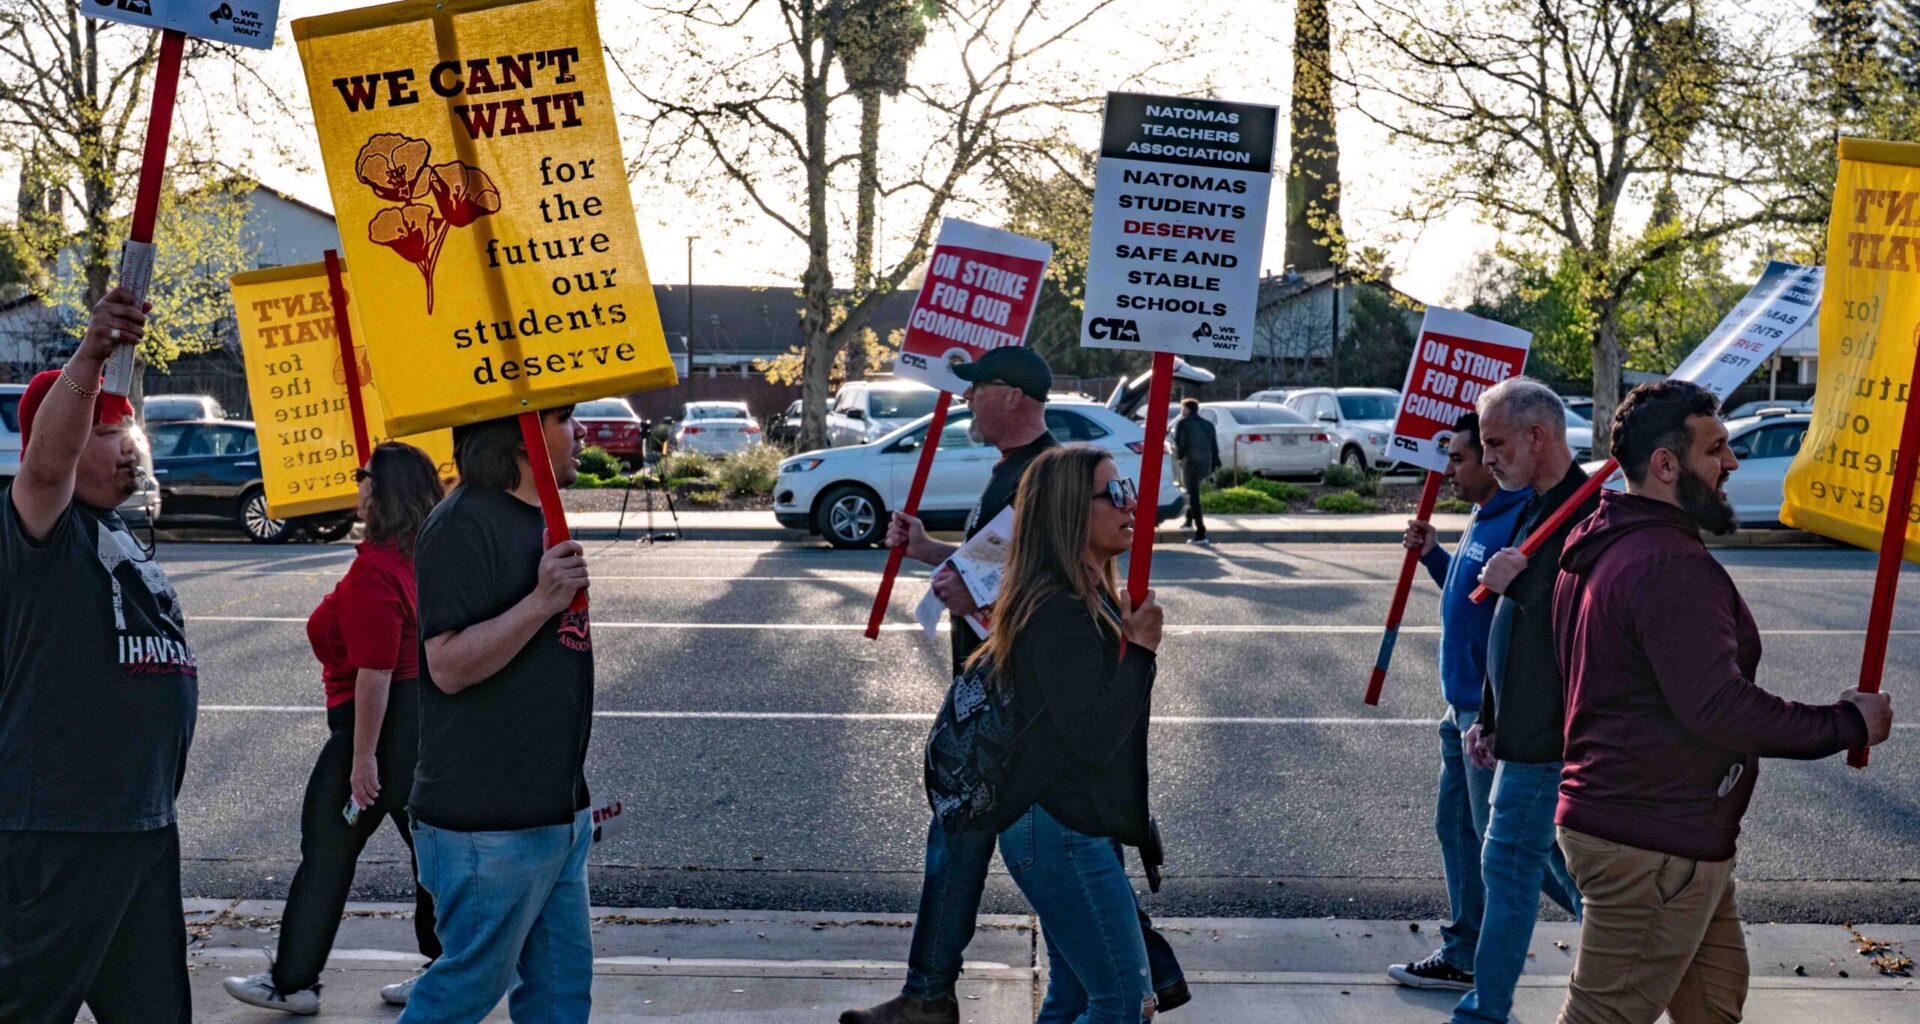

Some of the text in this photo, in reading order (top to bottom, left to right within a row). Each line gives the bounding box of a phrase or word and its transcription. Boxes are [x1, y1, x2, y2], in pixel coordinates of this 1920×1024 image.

[240, 9, 259, 19] WE
[233, 25, 261, 37] WAIT
[332, 47, 579, 112] WE CAN'T
[453, 91, 585, 140] WAIT
[1145, 105, 1240, 124] NATOMAS
[1141, 124, 1240, 143] TEACHERS
[1126, 142, 1250, 164] ASSOCIATION
[539, 156, 595, 185] for
[1123, 169, 1247, 194] NATOMAS
[539, 194, 603, 223] the
[1118, 195, 1246, 219] STUDENTS
[1123, 220, 1236, 243] DESERVE
[486, 232, 610, 268] future
[1116, 245, 1238, 268] SAFE AND
[552, 268, 617, 295] our
[932, 253, 1029, 300] ON STRIKE
[1127, 271, 1221, 292] STABLE
[930, 282, 1012, 326] FOR OUR
[1116, 295, 1227, 317] SCHOOLS
[453, 302, 627, 349] students
[912, 308, 1021, 351] COMMUNITY
[1089, 317, 1141, 343] CTA
[1213, 341, 1238, 350] WAIT
[1422, 340, 1449, 367] ON
[473, 341, 636, 385] deserve
[901, 353, 927, 370] CTA
[1421, 368, 1458, 399] FOR
[1394, 437, 1418, 452] CTA
